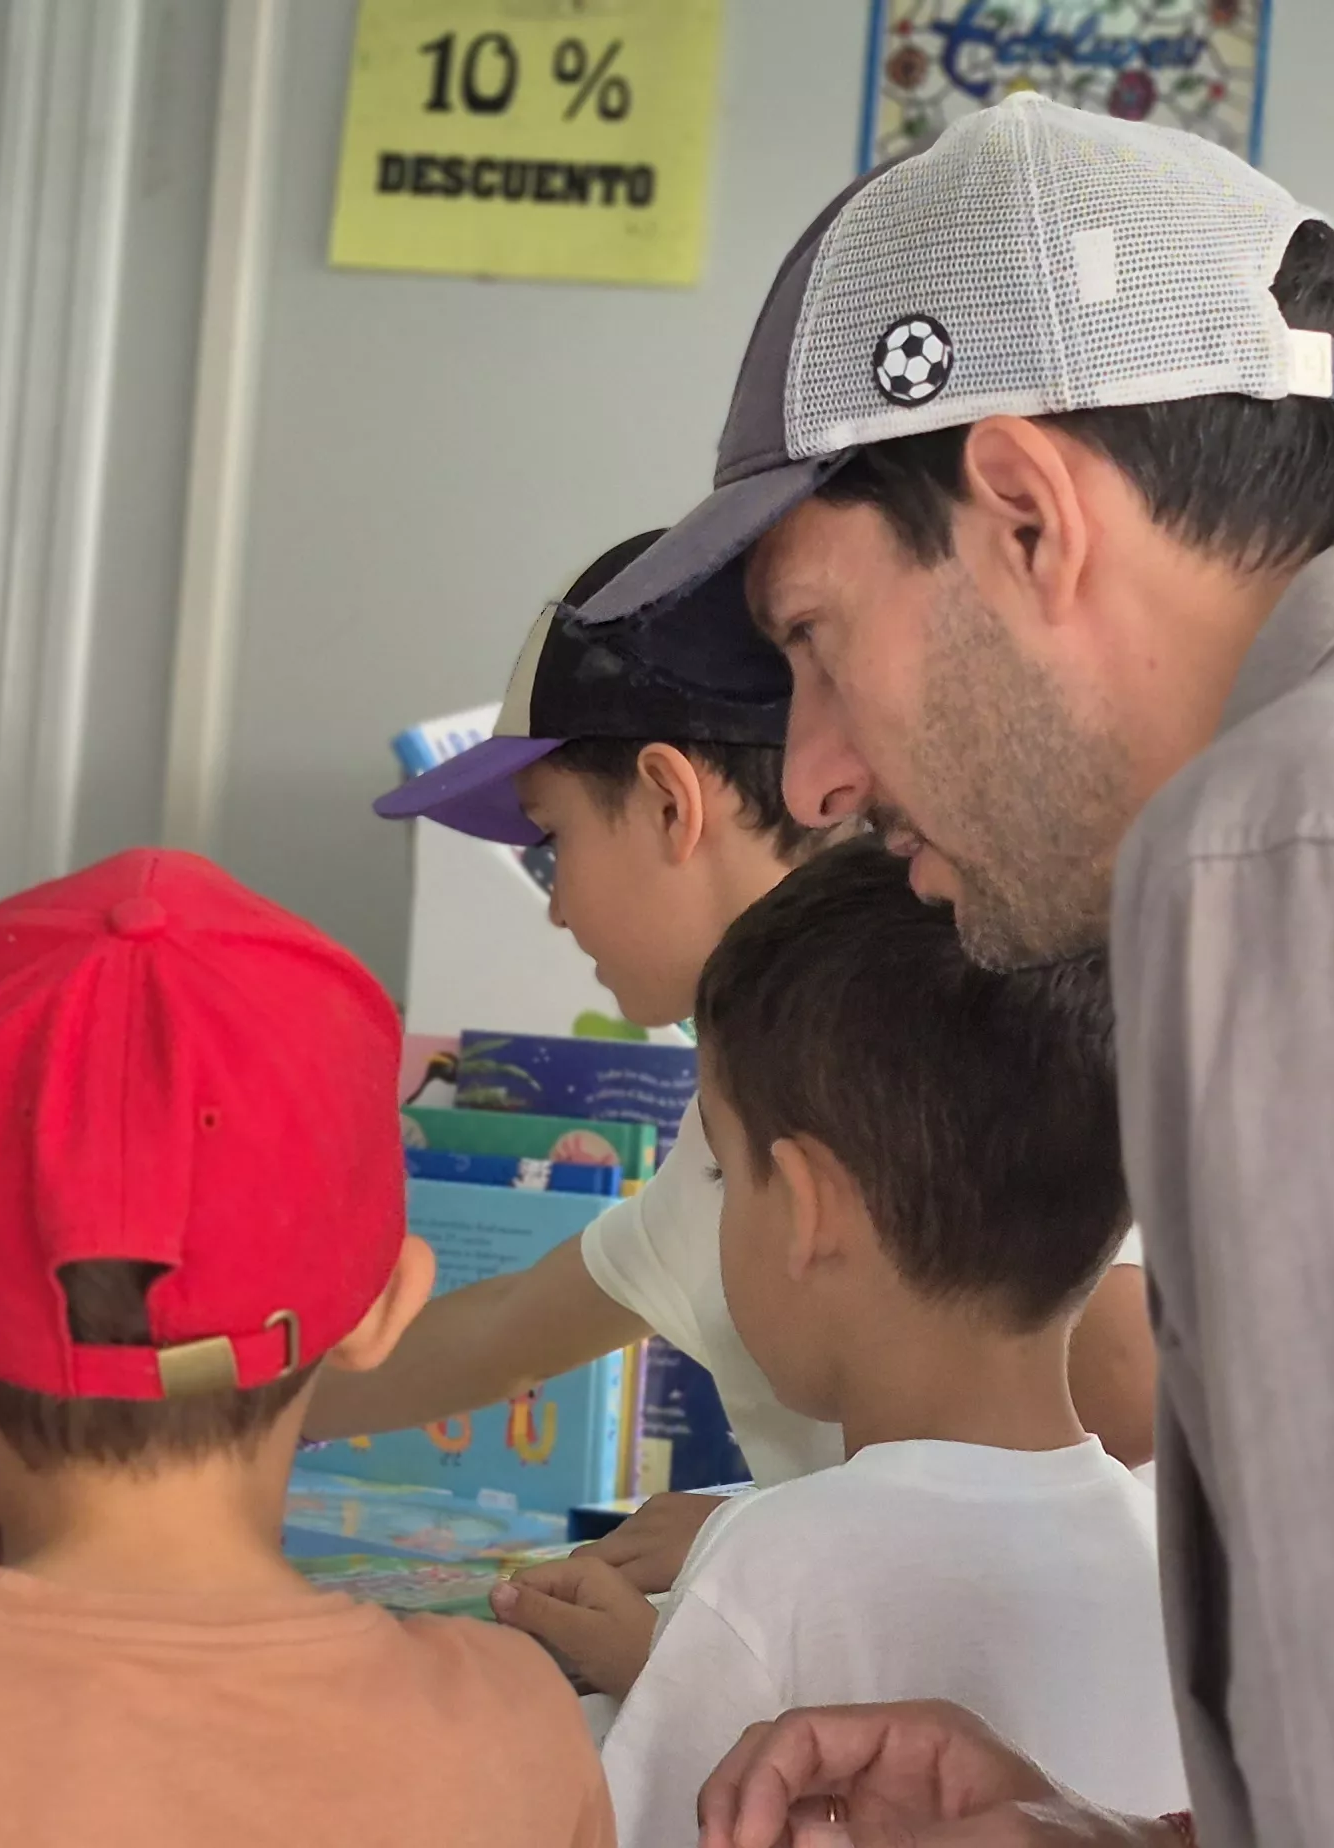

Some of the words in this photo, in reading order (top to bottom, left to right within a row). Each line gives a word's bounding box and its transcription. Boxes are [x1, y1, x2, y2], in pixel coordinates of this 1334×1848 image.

[420, 30, 521, 116] 10
[552, 37, 633, 123] %
[375, 151, 657, 209] DESCUENTO
